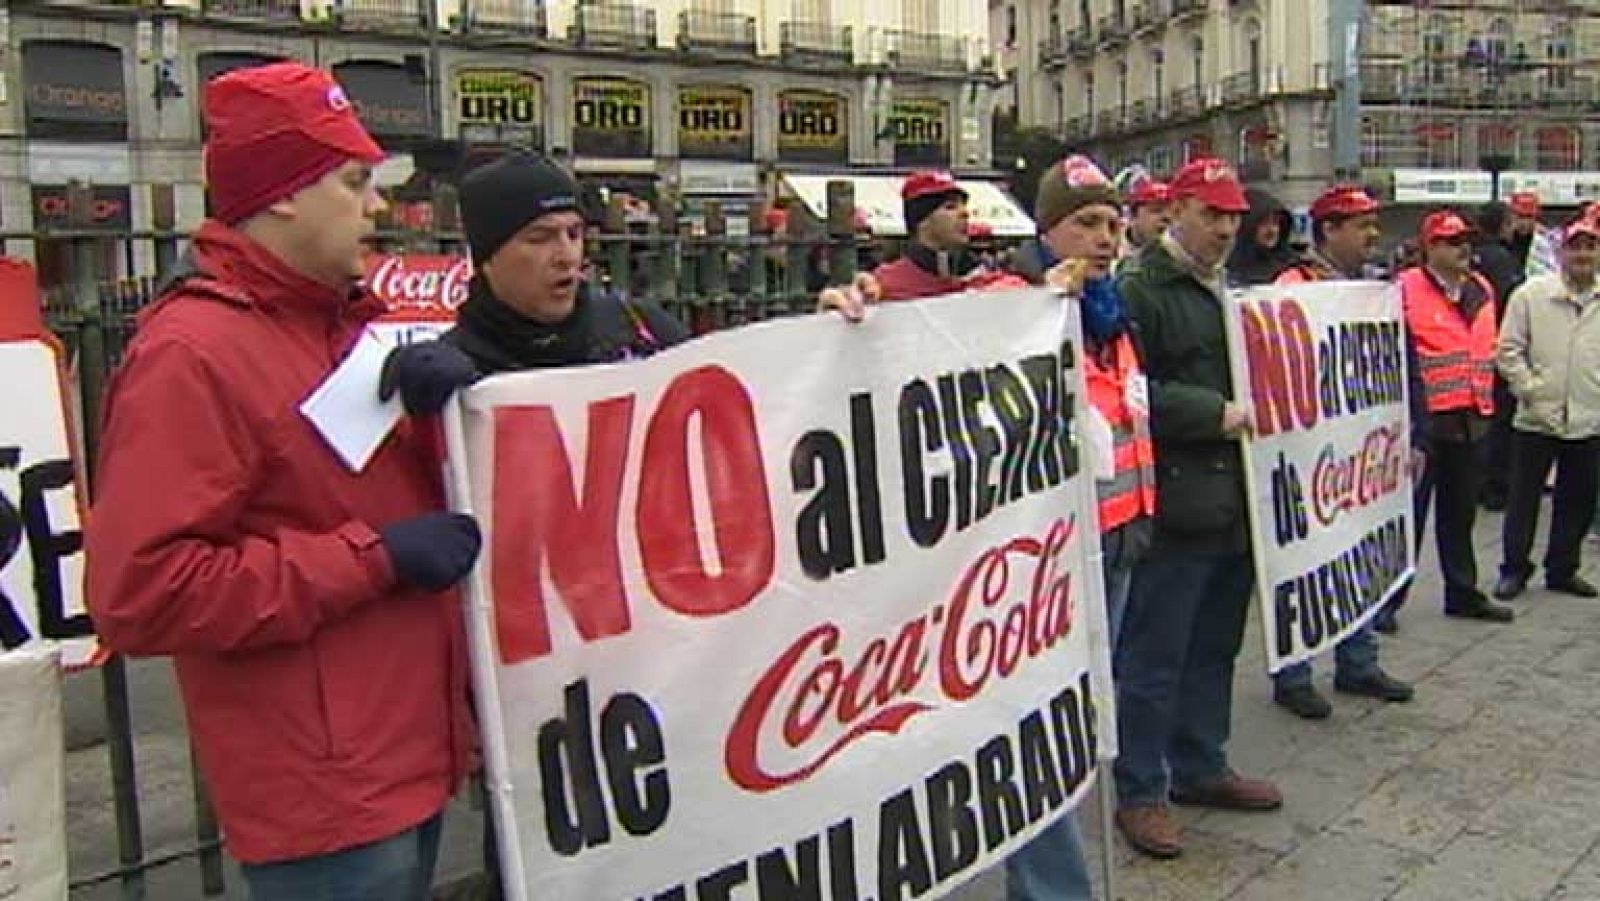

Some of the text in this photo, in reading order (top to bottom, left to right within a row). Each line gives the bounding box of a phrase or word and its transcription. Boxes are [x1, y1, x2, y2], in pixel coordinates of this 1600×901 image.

[462, 97, 534, 121] ORO
[575, 101, 642, 126] ORO
[681, 108, 742, 131] ORO
[781, 109, 838, 134] ORO
[1240, 299, 1319, 438] NO
[1319, 325, 1342, 418] al
[490, 338, 1080, 666] NO al CIERRE
[1271, 452, 1308, 547] de
[537, 678, 673, 857] de
